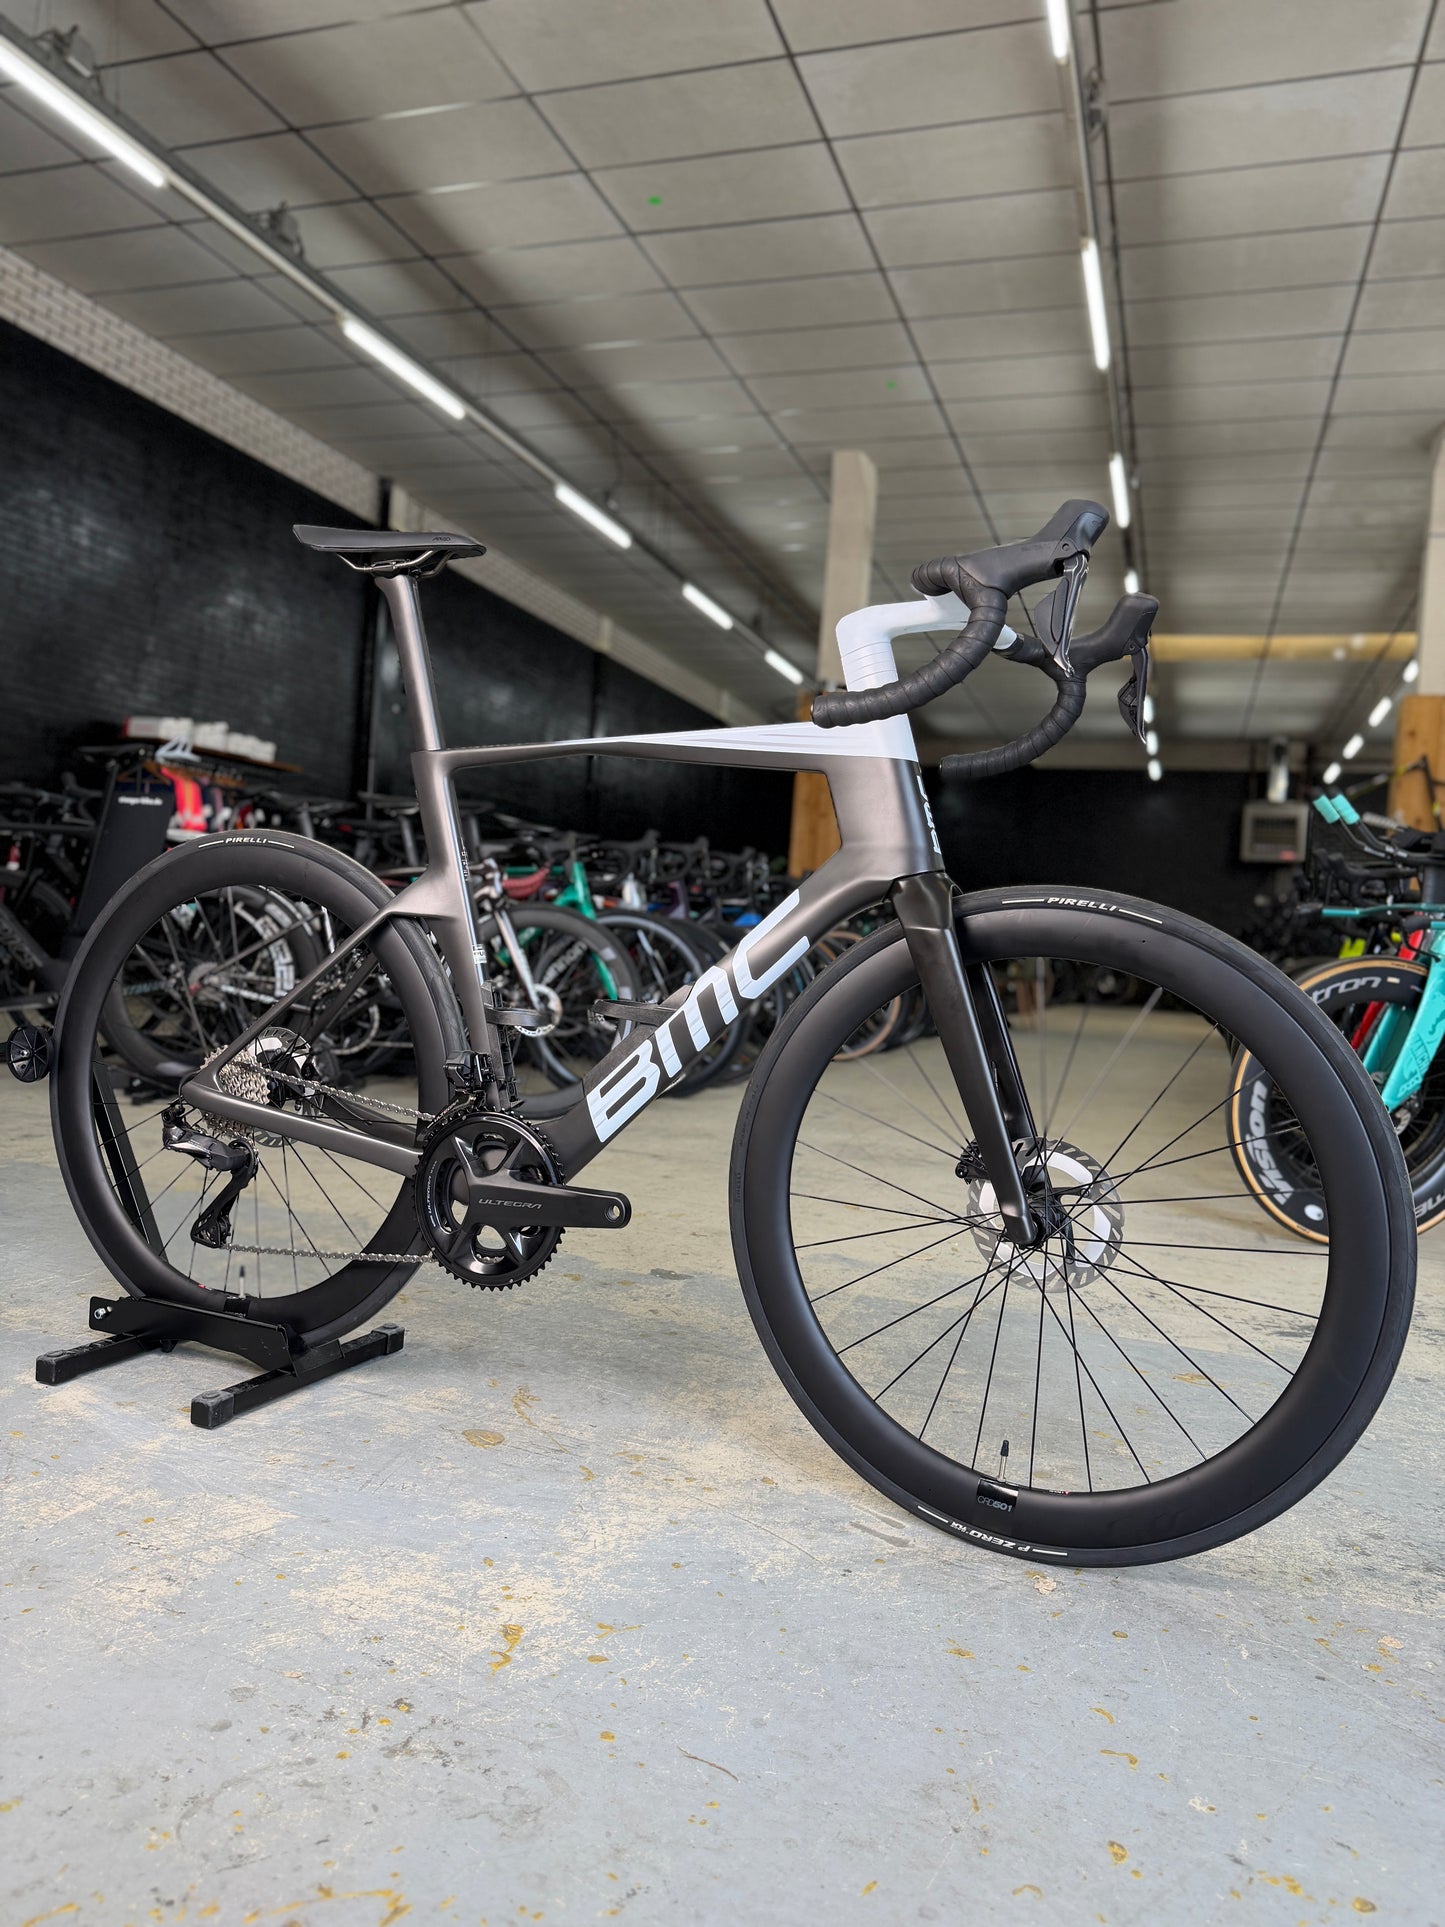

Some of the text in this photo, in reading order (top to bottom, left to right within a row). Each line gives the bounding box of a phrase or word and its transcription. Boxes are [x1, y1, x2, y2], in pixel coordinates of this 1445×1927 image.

[1047, 897, 1117, 911] PIRELLI
[586, 889, 811, 1143] BMC
[478, 1198, 543, 1210] ULTEGRA
[968, 1529, 1017, 1550] ZERO
